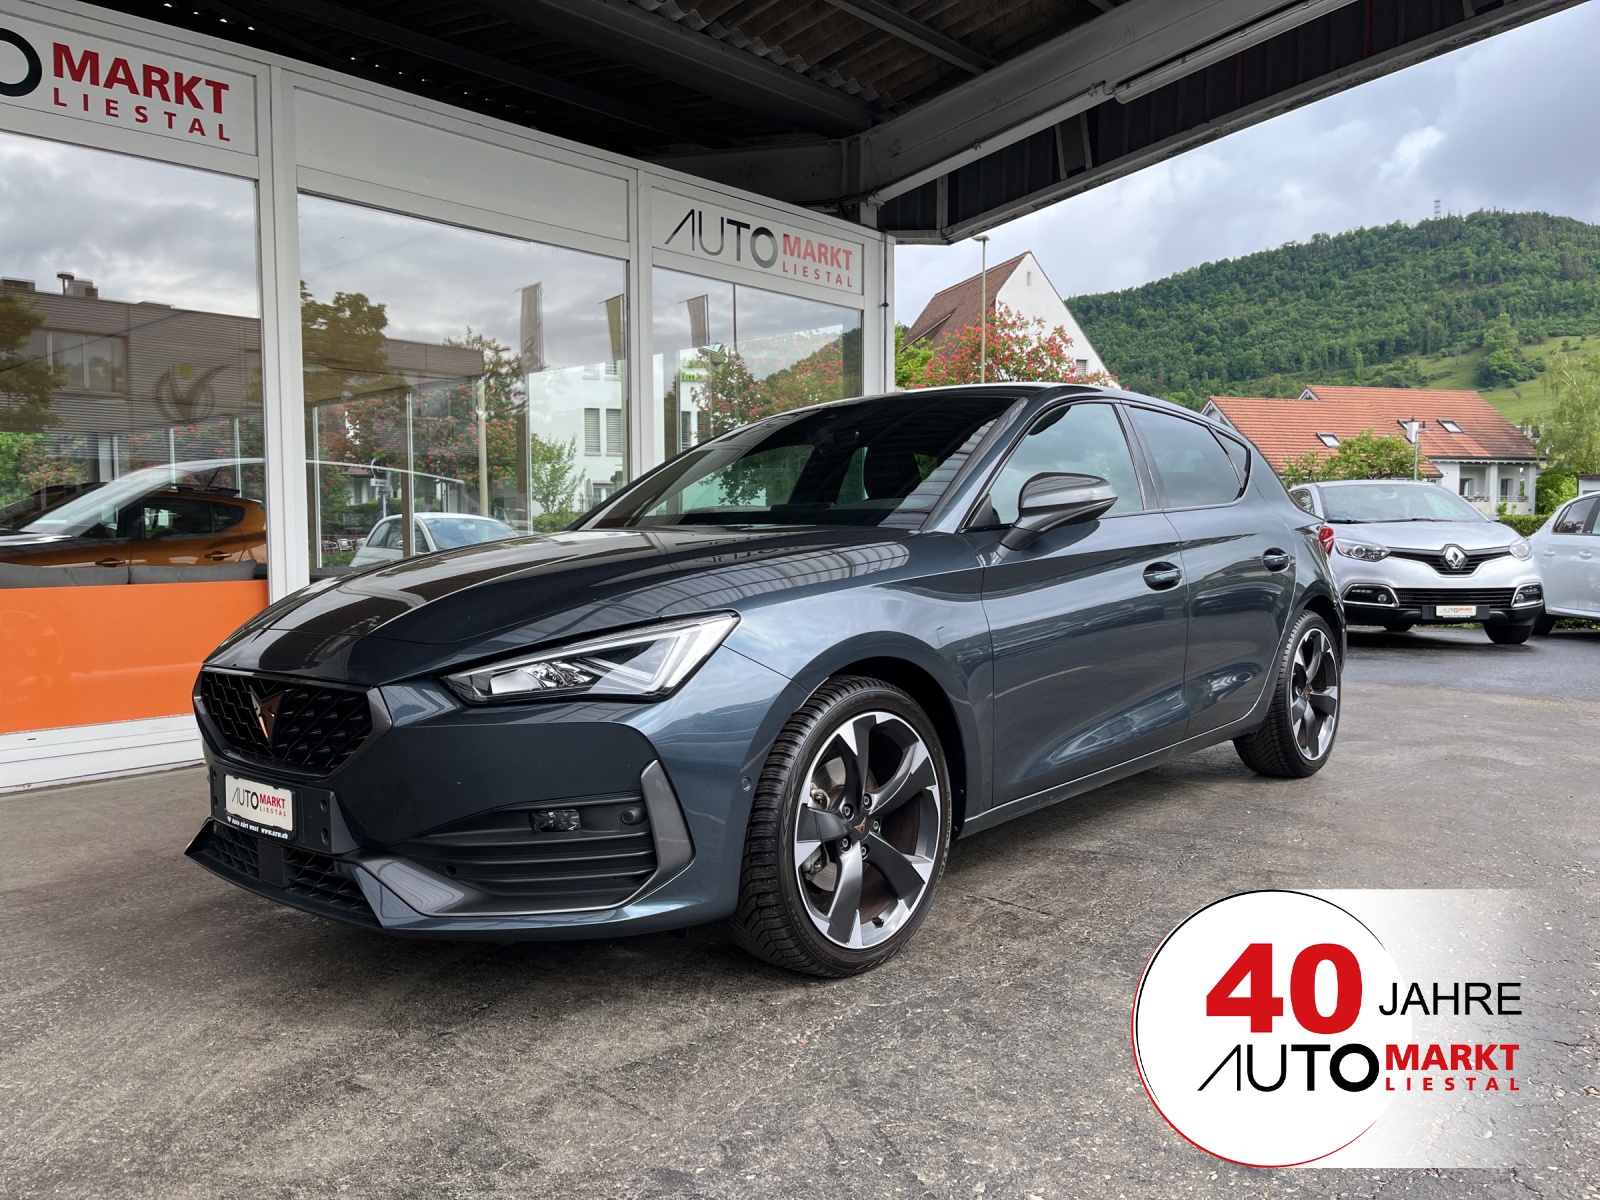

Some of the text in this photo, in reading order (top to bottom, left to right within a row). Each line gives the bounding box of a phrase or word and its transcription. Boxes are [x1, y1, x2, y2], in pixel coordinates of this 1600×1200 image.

[53, 42, 230, 115] MARKT
[53, 87, 231, 142] LIESTAL
[782, 233, 853, 271] MARKT
[782, 261, 853, 288] LIESTAL
[260, 793, 286, 809] MARKT
[260, 805, 286, 817] LIESTAL
